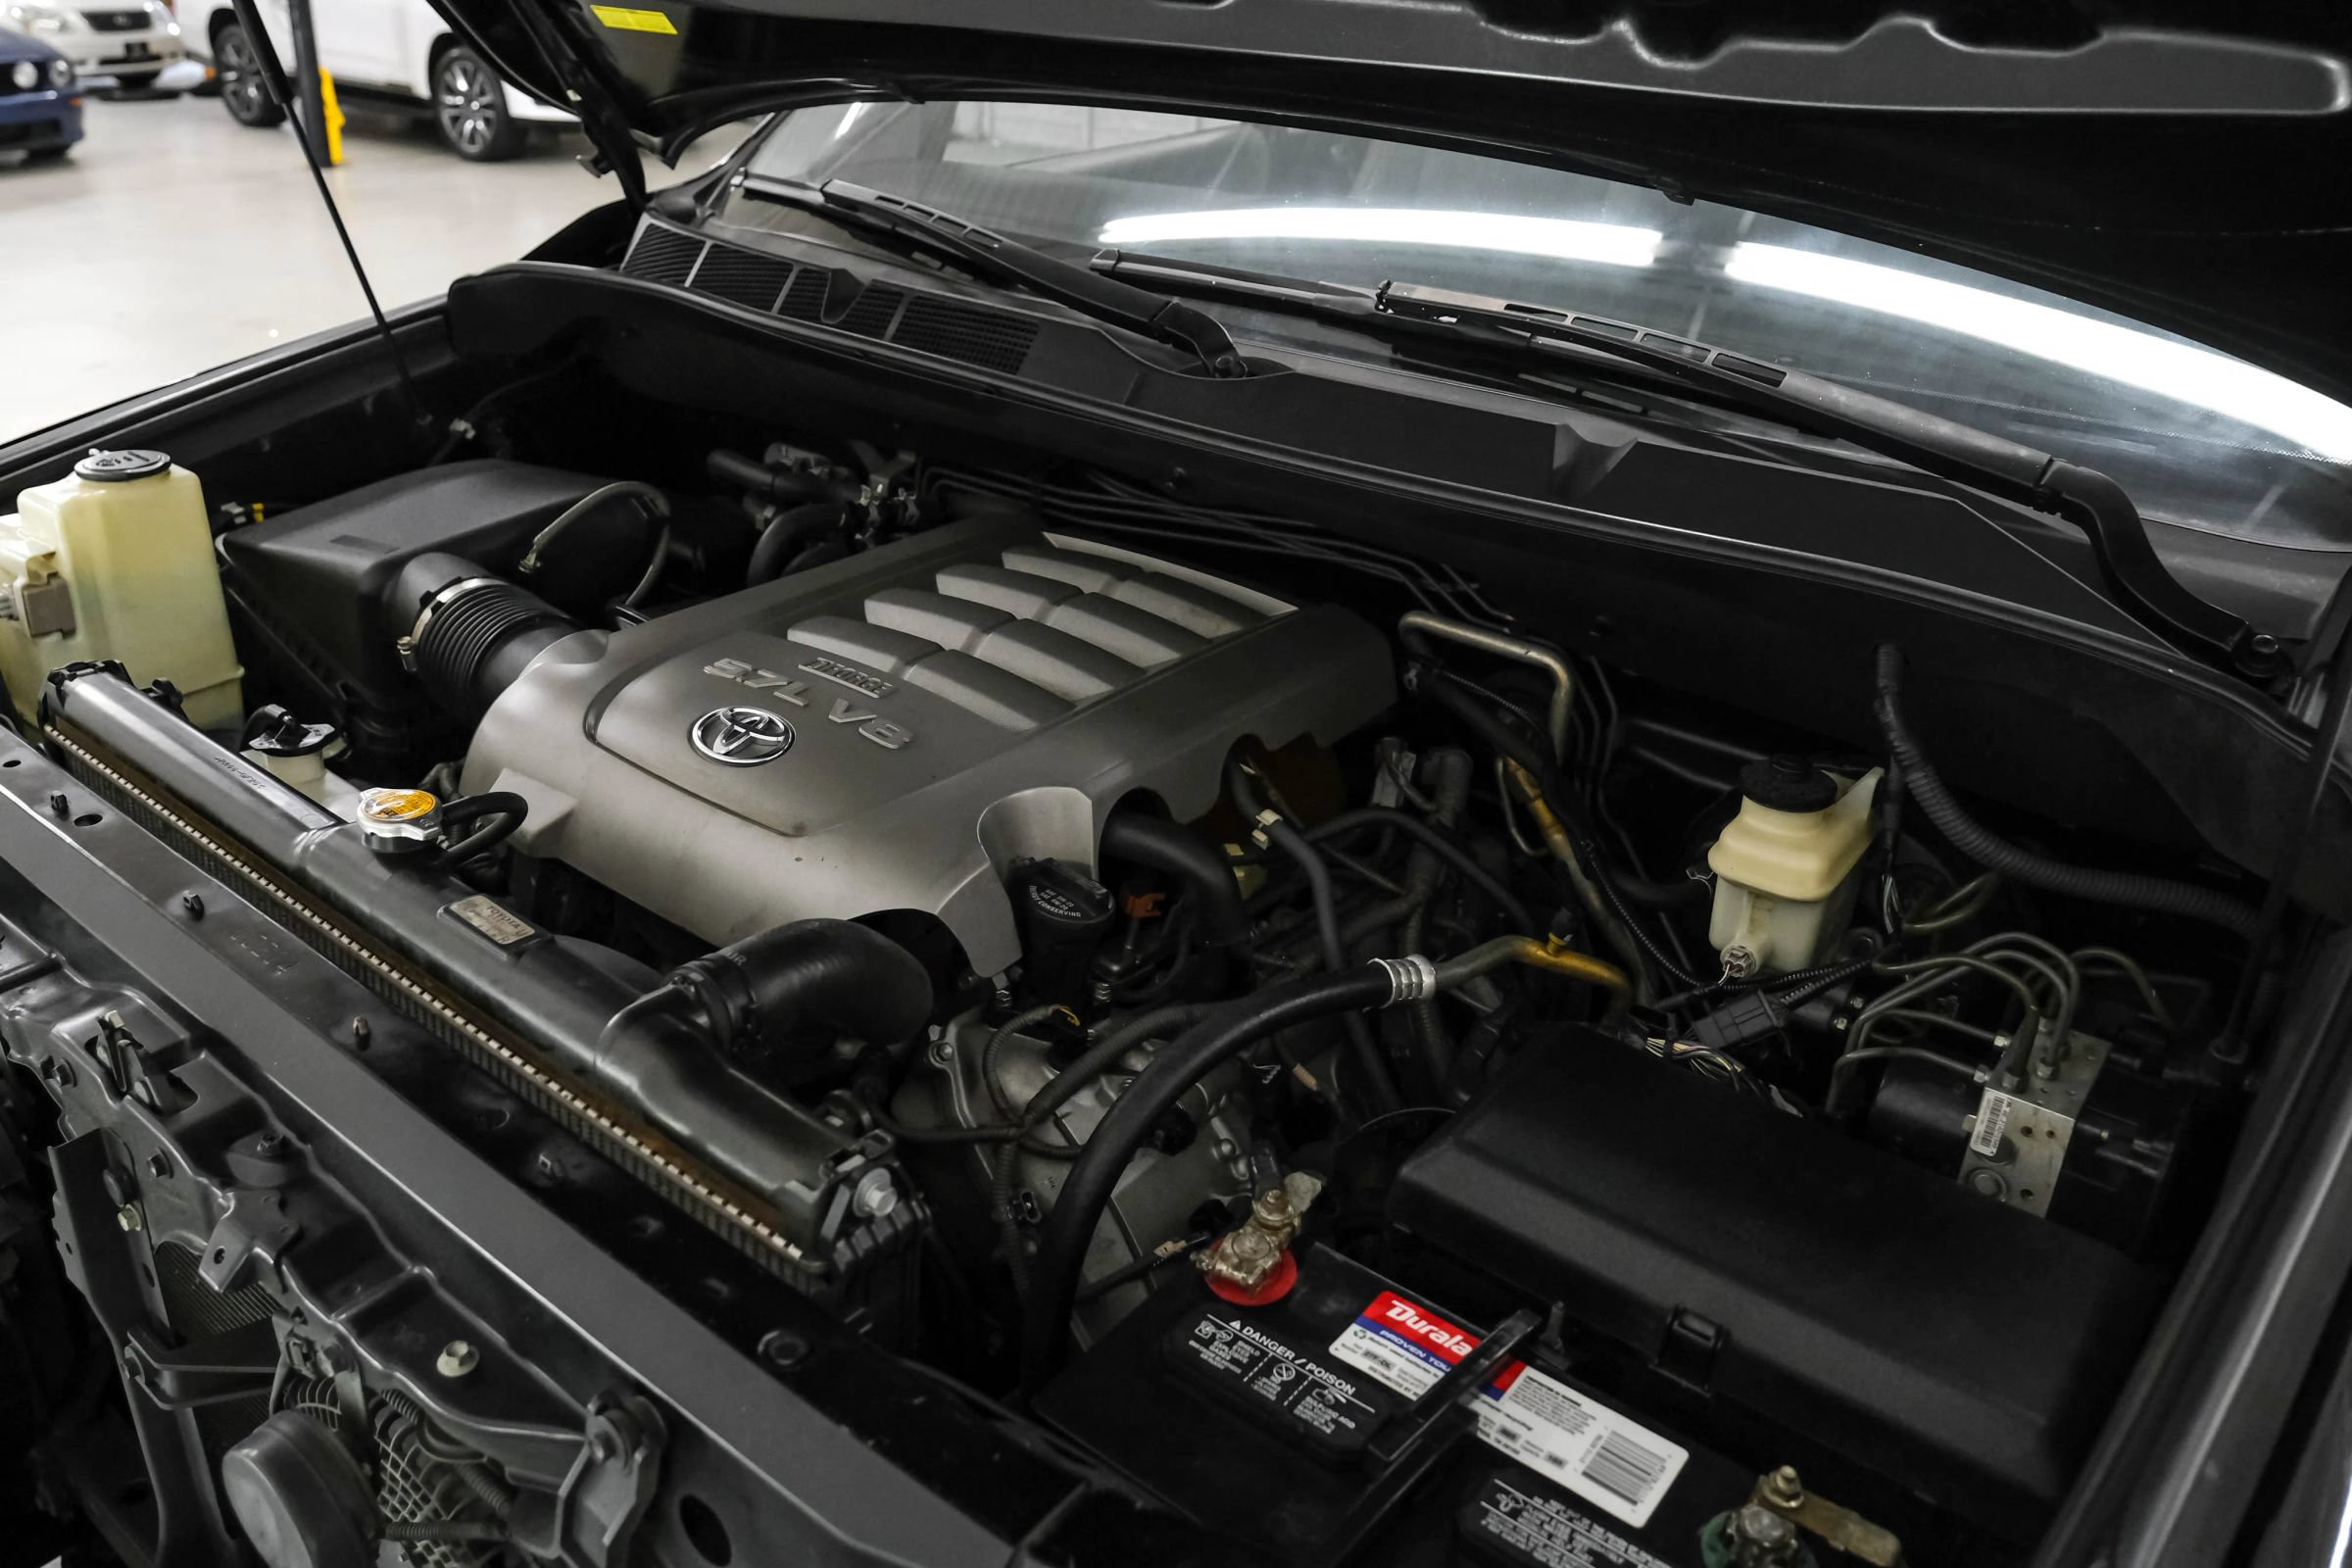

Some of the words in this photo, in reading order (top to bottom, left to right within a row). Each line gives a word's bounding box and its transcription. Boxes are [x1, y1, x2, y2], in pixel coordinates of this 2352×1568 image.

[828, 698, 913, 750] V8
[486, 906, 520, 929] TOYOTA
[1379, 1329, 1428, 1359] PROVEN
[1385, 1298, 1474, 1357] Durala
[1242, 1325, 1296, 1361] DANGER
[1304, 1361, 1356, 1396] POISON
